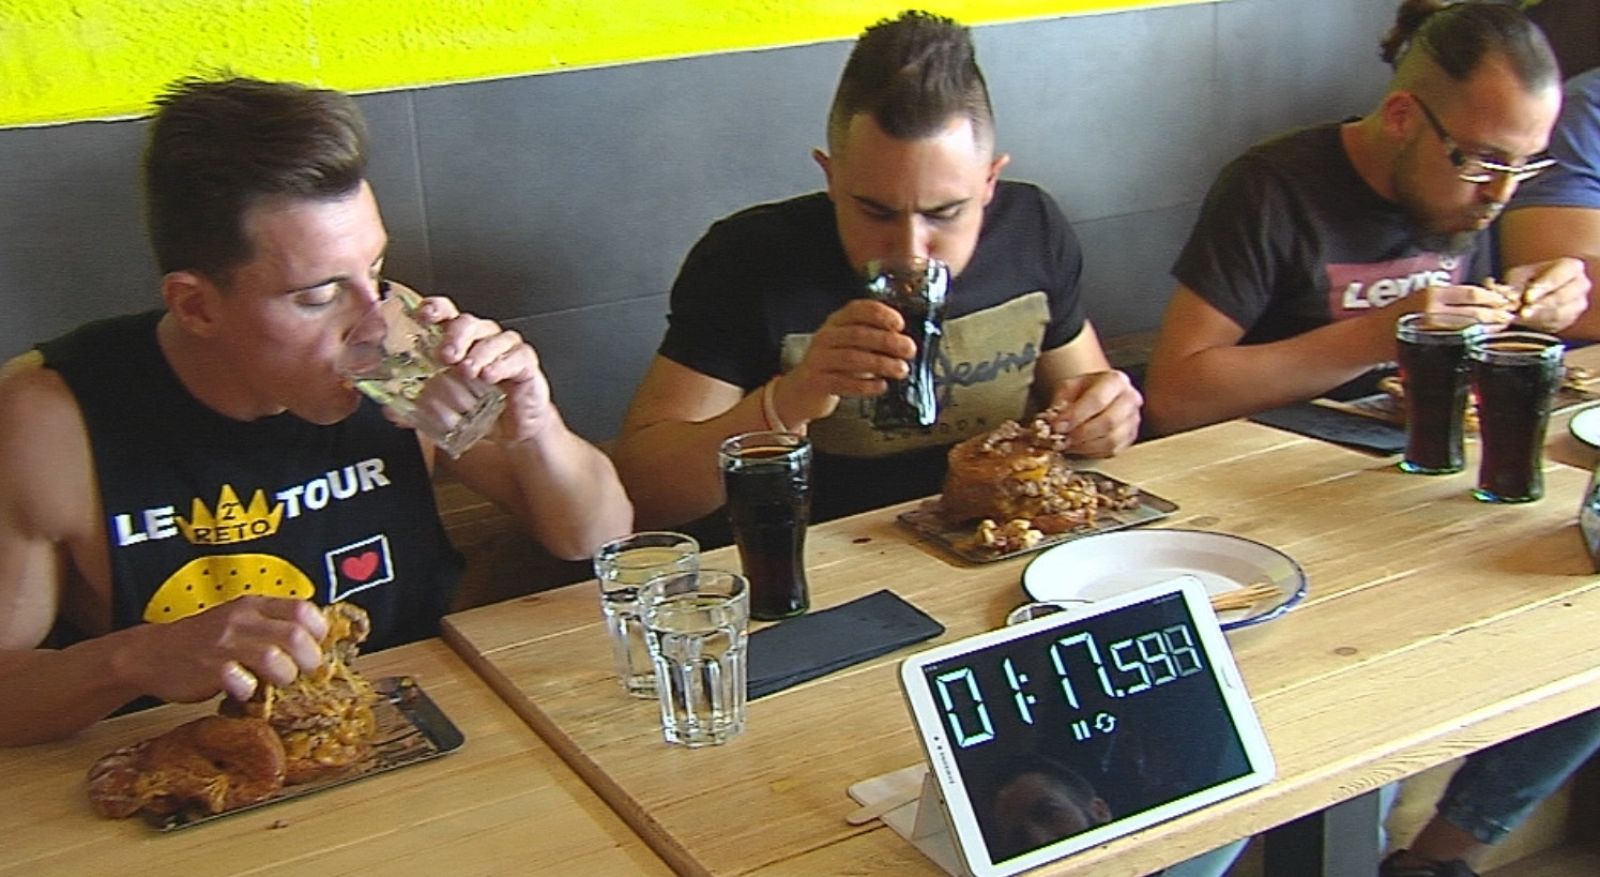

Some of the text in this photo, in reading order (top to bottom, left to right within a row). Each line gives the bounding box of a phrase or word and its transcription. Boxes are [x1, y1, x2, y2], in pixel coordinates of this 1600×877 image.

[112, 457, 391, 546] LE TOUR
[193, 519, 271, 541] RETO
